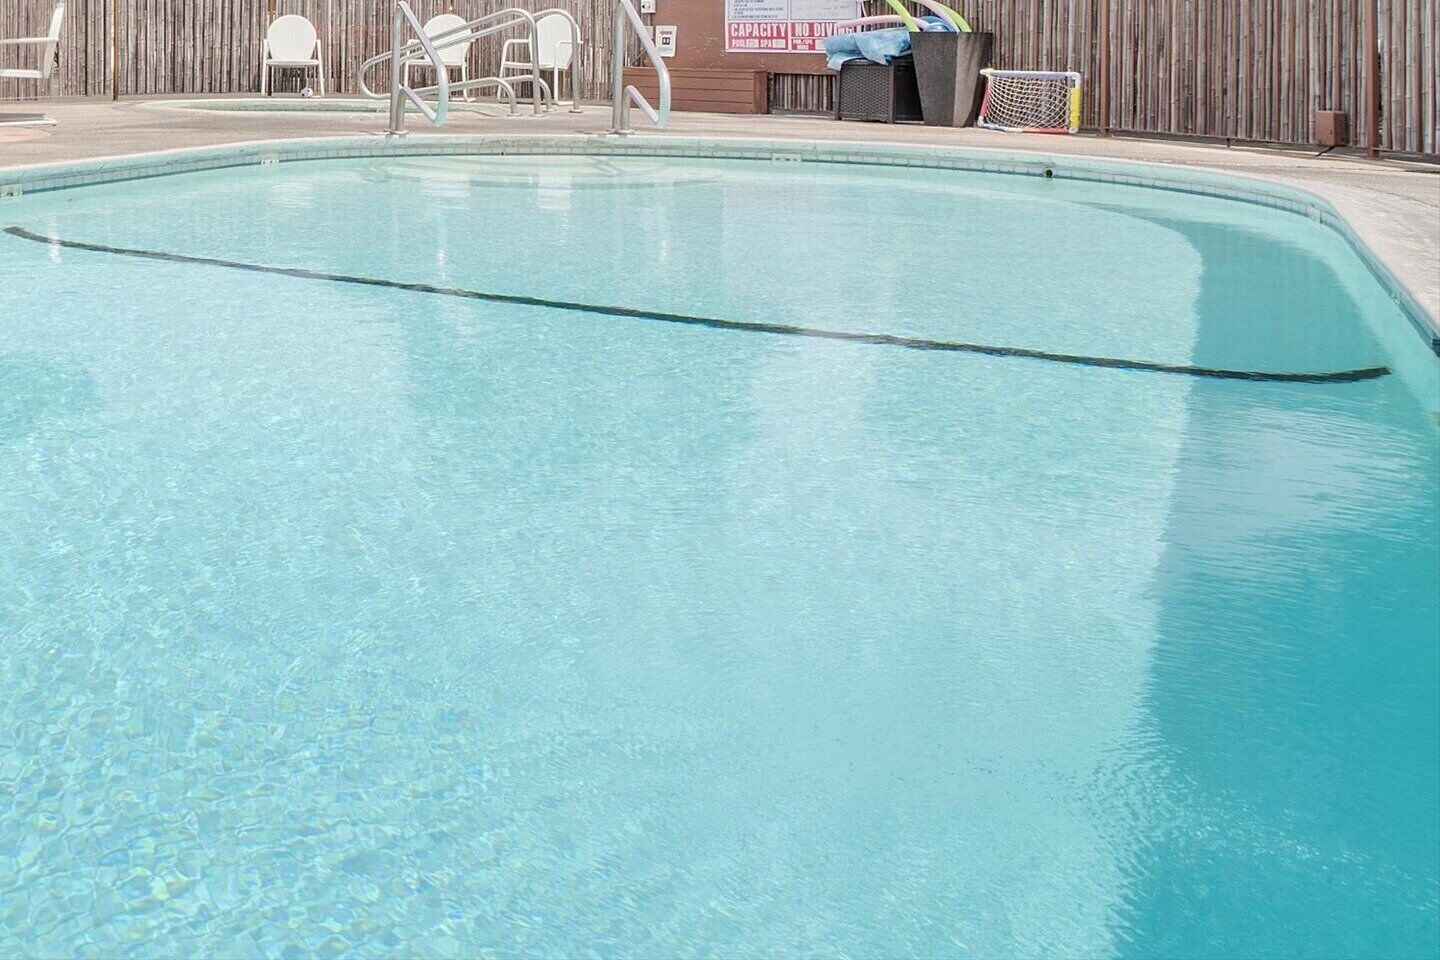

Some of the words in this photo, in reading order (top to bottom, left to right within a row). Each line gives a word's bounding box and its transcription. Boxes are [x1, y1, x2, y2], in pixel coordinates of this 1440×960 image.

[731, 23, 786, 37] CAPACITY
[795, 23, 810, 37] NO
[760, 39, 772, 48] SPA
